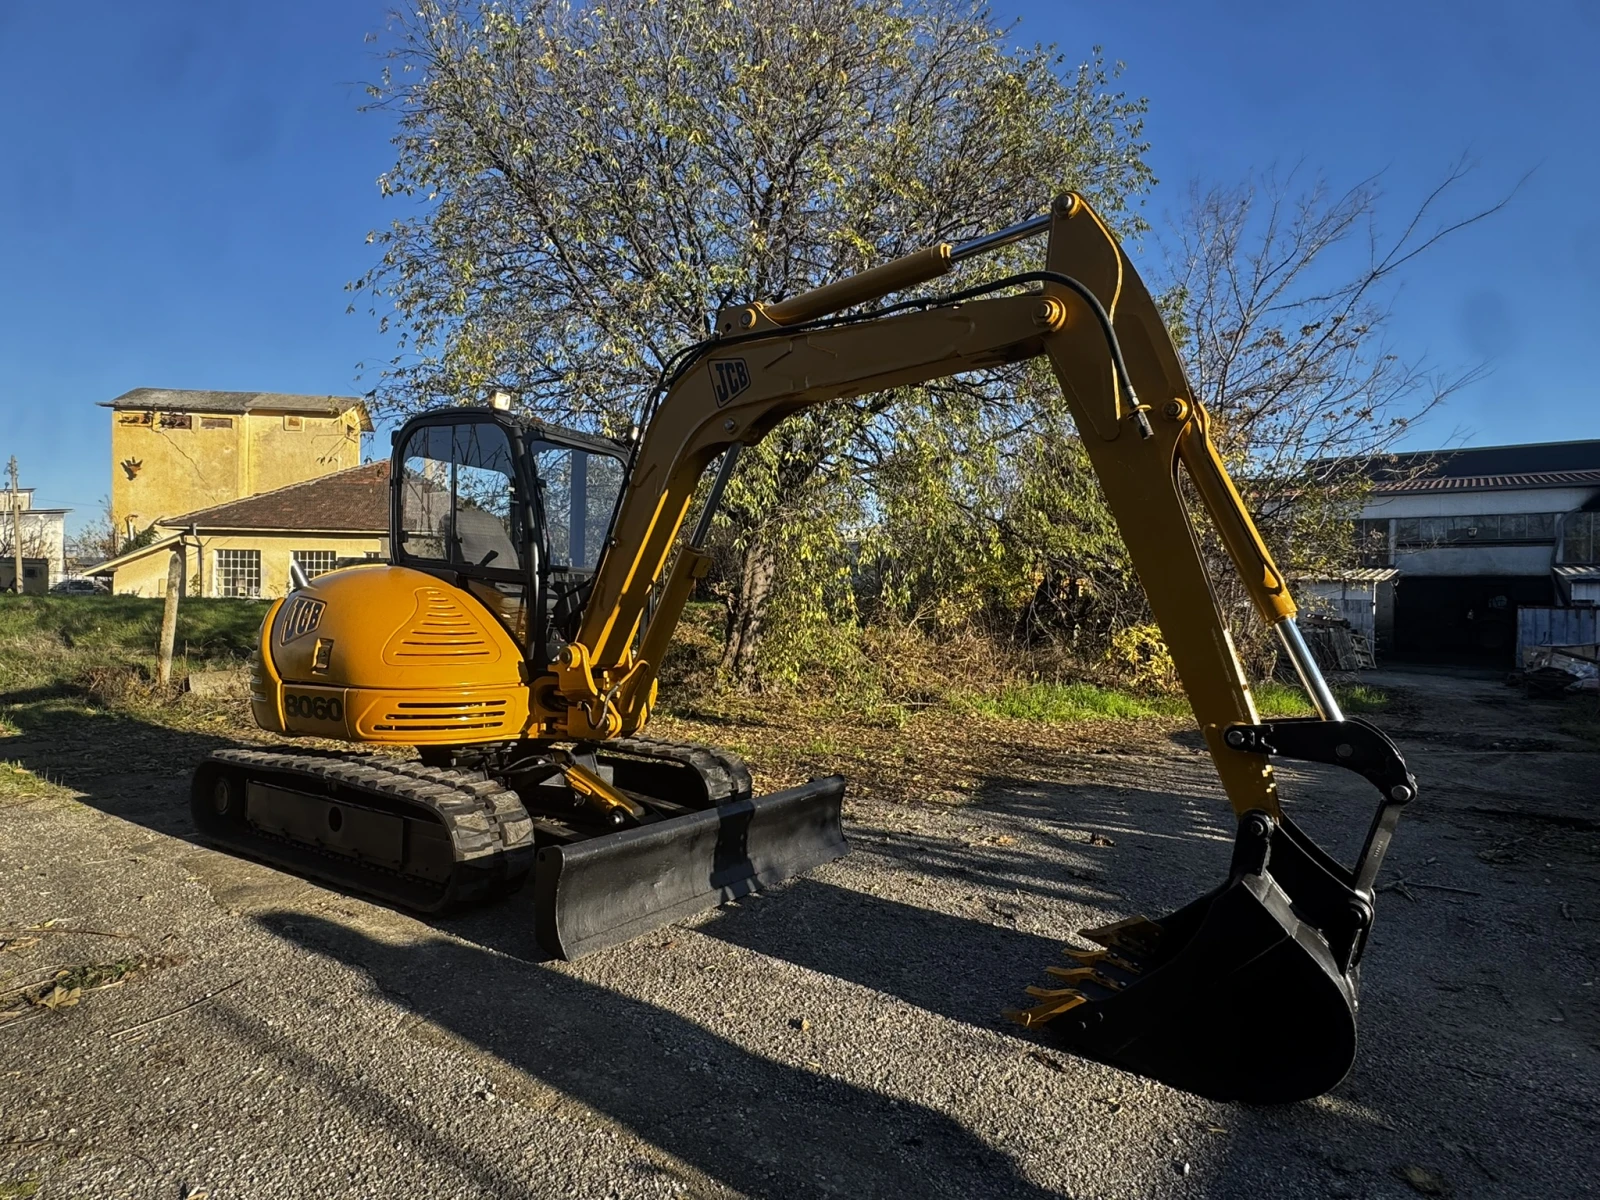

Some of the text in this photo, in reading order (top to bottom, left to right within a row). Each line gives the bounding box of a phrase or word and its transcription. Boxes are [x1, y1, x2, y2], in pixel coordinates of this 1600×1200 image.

[715, 361, 748, 402] JCB
[283, 599, 323, 641] JCB
[284, 694, 343, 721] 8060
